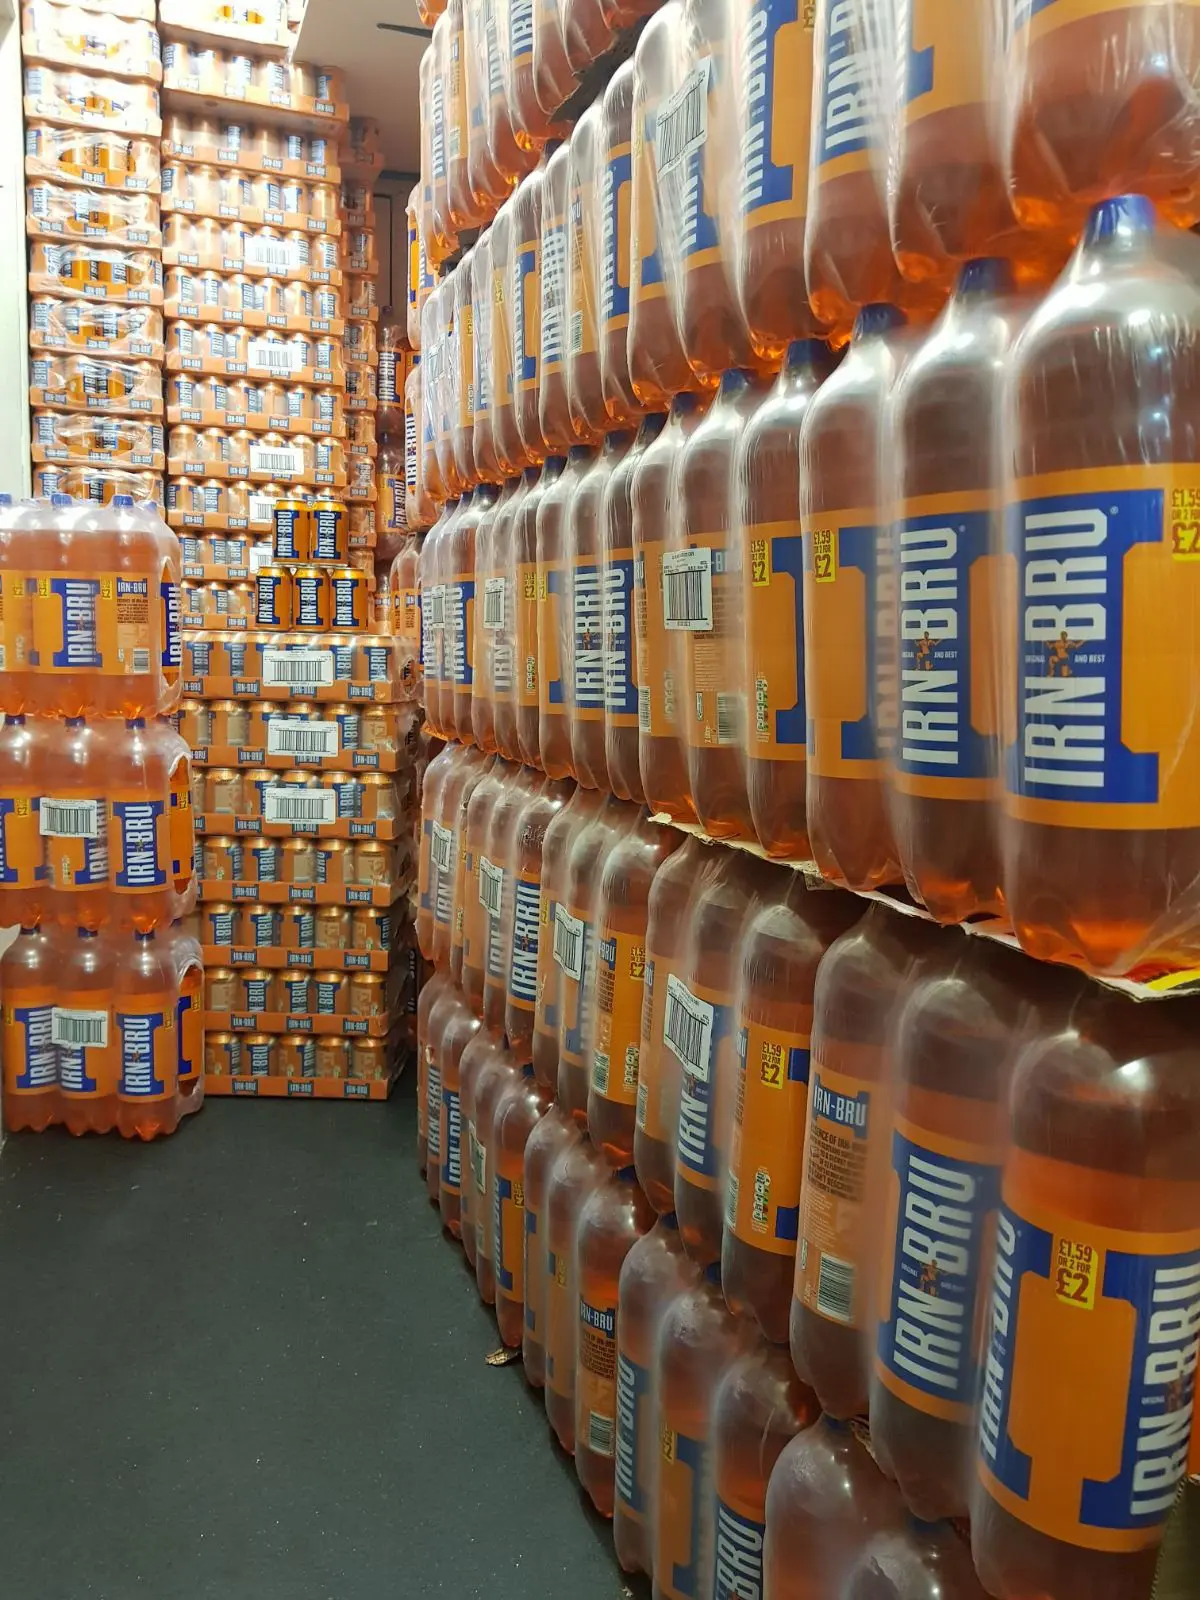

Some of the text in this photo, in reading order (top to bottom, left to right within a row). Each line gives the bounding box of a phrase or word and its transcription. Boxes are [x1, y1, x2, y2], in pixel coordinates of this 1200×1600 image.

[278, 511, 293, 557] IRN BRU
[319, 511, 335, 557] IRN BRU
[814, 530, 831, 545] £1.59
[1172, 522, 1200, 554] £2
[752, 561, 766, 582] £2
[815, 554, 831, 578] £2
[117, 582, 146, 594] IRN-BRU
[259, 578, 274, 622] IRN BRU
[302, 579, 317, 624] IRN BRU
[337, 580, 352, 625] IRN BRU
[66, 582, 93, 663] IRN BRU
[575, 573, 604, 701] IRN BRU
[901, 527, 958, 764] IRN BRU
[945, 651, 957, 659] BEST
[1024, 508, 1108, 787] IRN BRU
[1075, 654, 1088, 663] AND
[1089, 654, 1106, 663] BEST
[236, 682, 258, 693] IRN-BRU
[350, 687, 372, 697] IRN-BRU
[241, 751, 262, 761] IRN-BRU
[355, 754, 377, 765] IRN-BRU
[238, 820, 260, 830] IRN-BRU
[352, 823, 374, 834] IRN-BRU
[125, 805, 155, 883] IRN BRU
[512, 884, 540, 996] IRN BRU
[630, 962, 645, 978] £2
[124, 1018, 151, 1092] IRN BRU
[762, 1041, 781, 1057] £1.59
[772, 1056, 781, 1065] FOR
[61, 1057, 82, 1089] IRN
[761, 1062, 780, 1085] £2
[814, 1085, 867, 1126] IRN-BRU
[678, 1088, 708, 1164] IRN
[1058, 1238, 1093, 1263] £1.59
[1058, 1255, 1091, 1274] OR 2 FOR
[894, 1154, 976, 1390] IRN BRU
[1056, 1267, 1090, 1303] £2
[1130, 1262, 1200, 1515] IRN BRU
[716, 1503, 763, 1600] BRU
